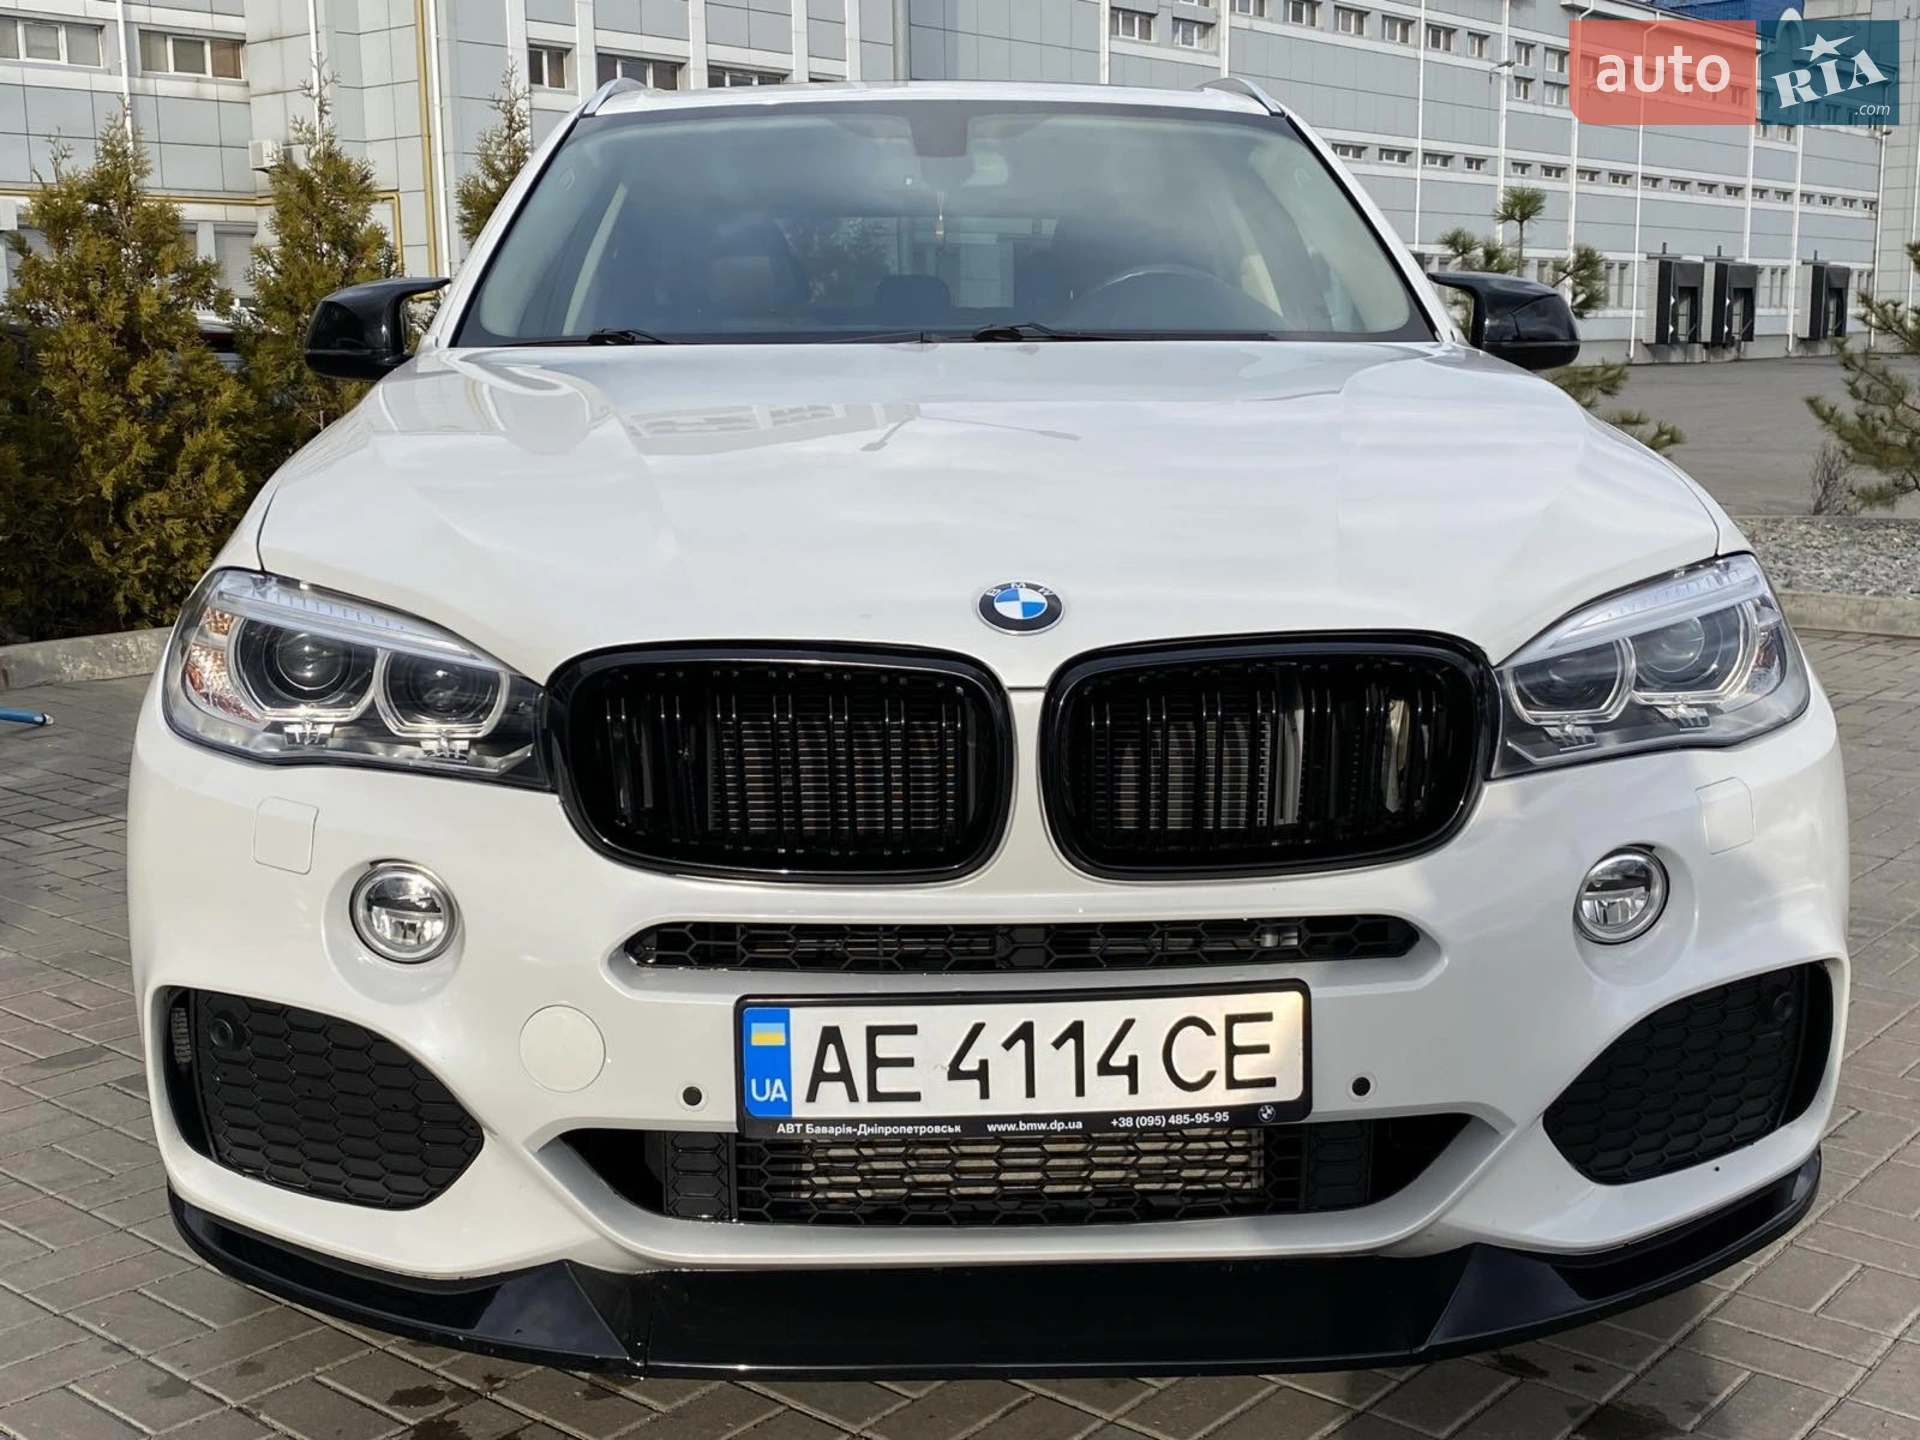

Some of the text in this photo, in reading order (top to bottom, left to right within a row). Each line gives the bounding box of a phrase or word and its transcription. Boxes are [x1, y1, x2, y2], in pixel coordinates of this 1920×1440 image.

[985, 581, 1055, 597] BMW
[805, 1011, 1277, 1103] AE 4114 CE
[750, 1077, 788, 1102] UA
[986, 1119, 1083, 1132] www.bmw.dp.ua
[1110, 1111, 1230, 1128] +38 (095) 485-95-95
